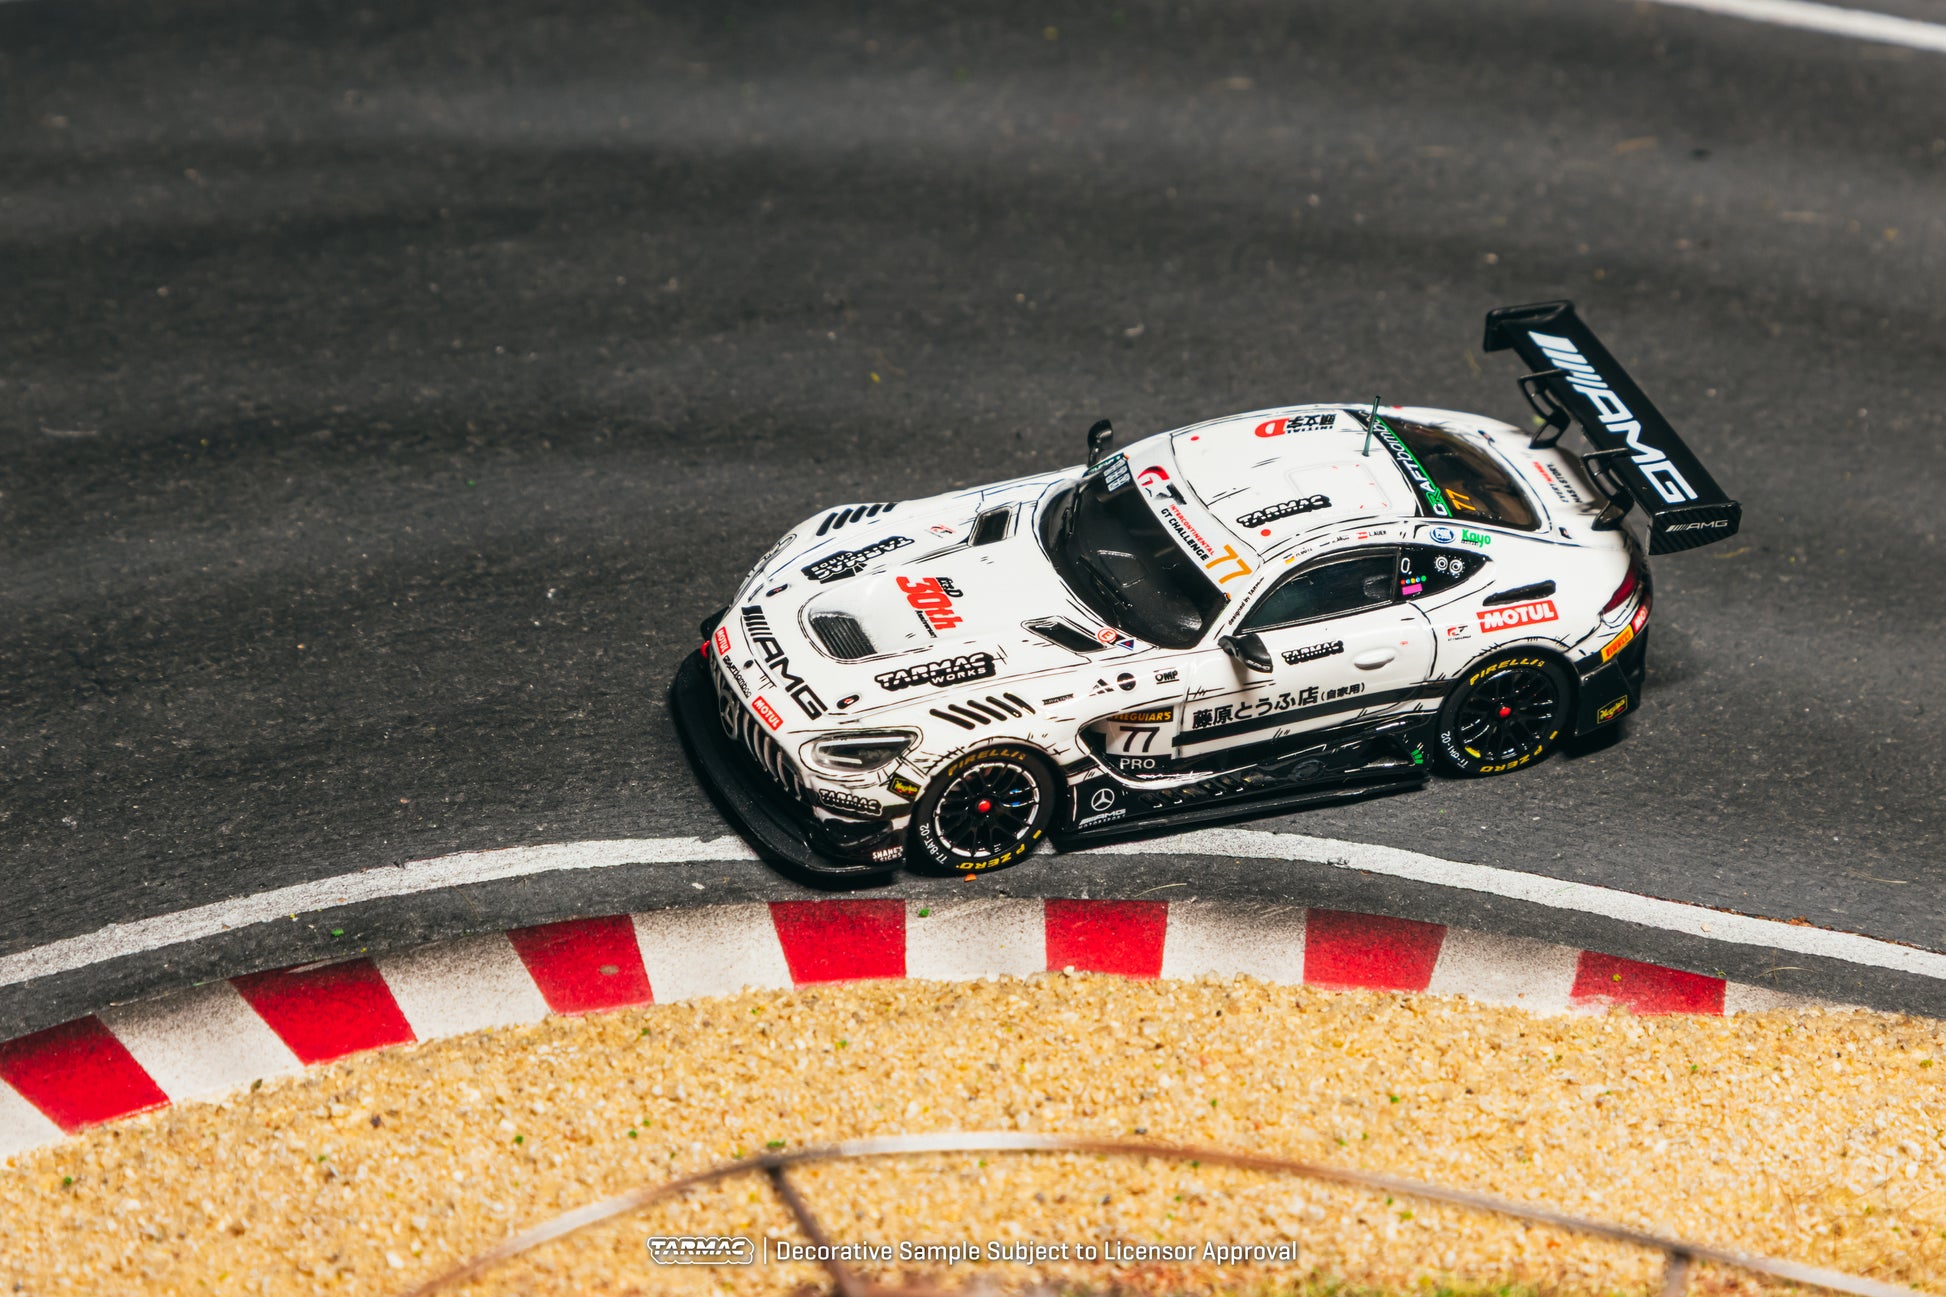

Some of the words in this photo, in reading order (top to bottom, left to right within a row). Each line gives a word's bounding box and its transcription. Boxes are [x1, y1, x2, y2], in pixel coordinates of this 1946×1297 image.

[1572, 384, 1698, 503] AMG
[1238, 496, 1328, 526] TARMAC
[1445, 488, 1476, 511] 77
[1161, 508, 1172, 518] GT
[1168, 517, 1209, 561] CHALLENGE
[1170, 503, 1215, 556] INTERCONTINENTAL
[1462, 529, 1491, 547] Kayo
[1684, 519, 1728, 531] AMG
[814, 537, 914, 579] TARMAC
[1205, 544, 1253, 584] 77
[896, 576, 963, 631] 30th
[1228, 602, 1245, 625] designed
[1484, 603, 1554, 629] MOTUL
[716, 628, 729, 653] MOTUL
[1283, 641, 1343, 663] TARMAC
[752, 637, 828, 720] AMG
[876, 653, 986, 688] TARMAC
[931, 667, 987, 684] WORKS
[1155, 670, 1178, 682] OMP
[1469, 658, 1539, 686] PIRELLI
[753, 698, 781, 728] MOTUL
[1120, 726, 1160, 752] 77
[948, 749, 1019, 776] PIRELLI
[1120, 758, 1155, 769] PRO
[1480, 754, 1531, 772] ZERO
[820, 789, 878, 811] TARMAC
[920, 823, 948, 865] 77-BAT-02
[959, 852, 1012, 870] ZERO
